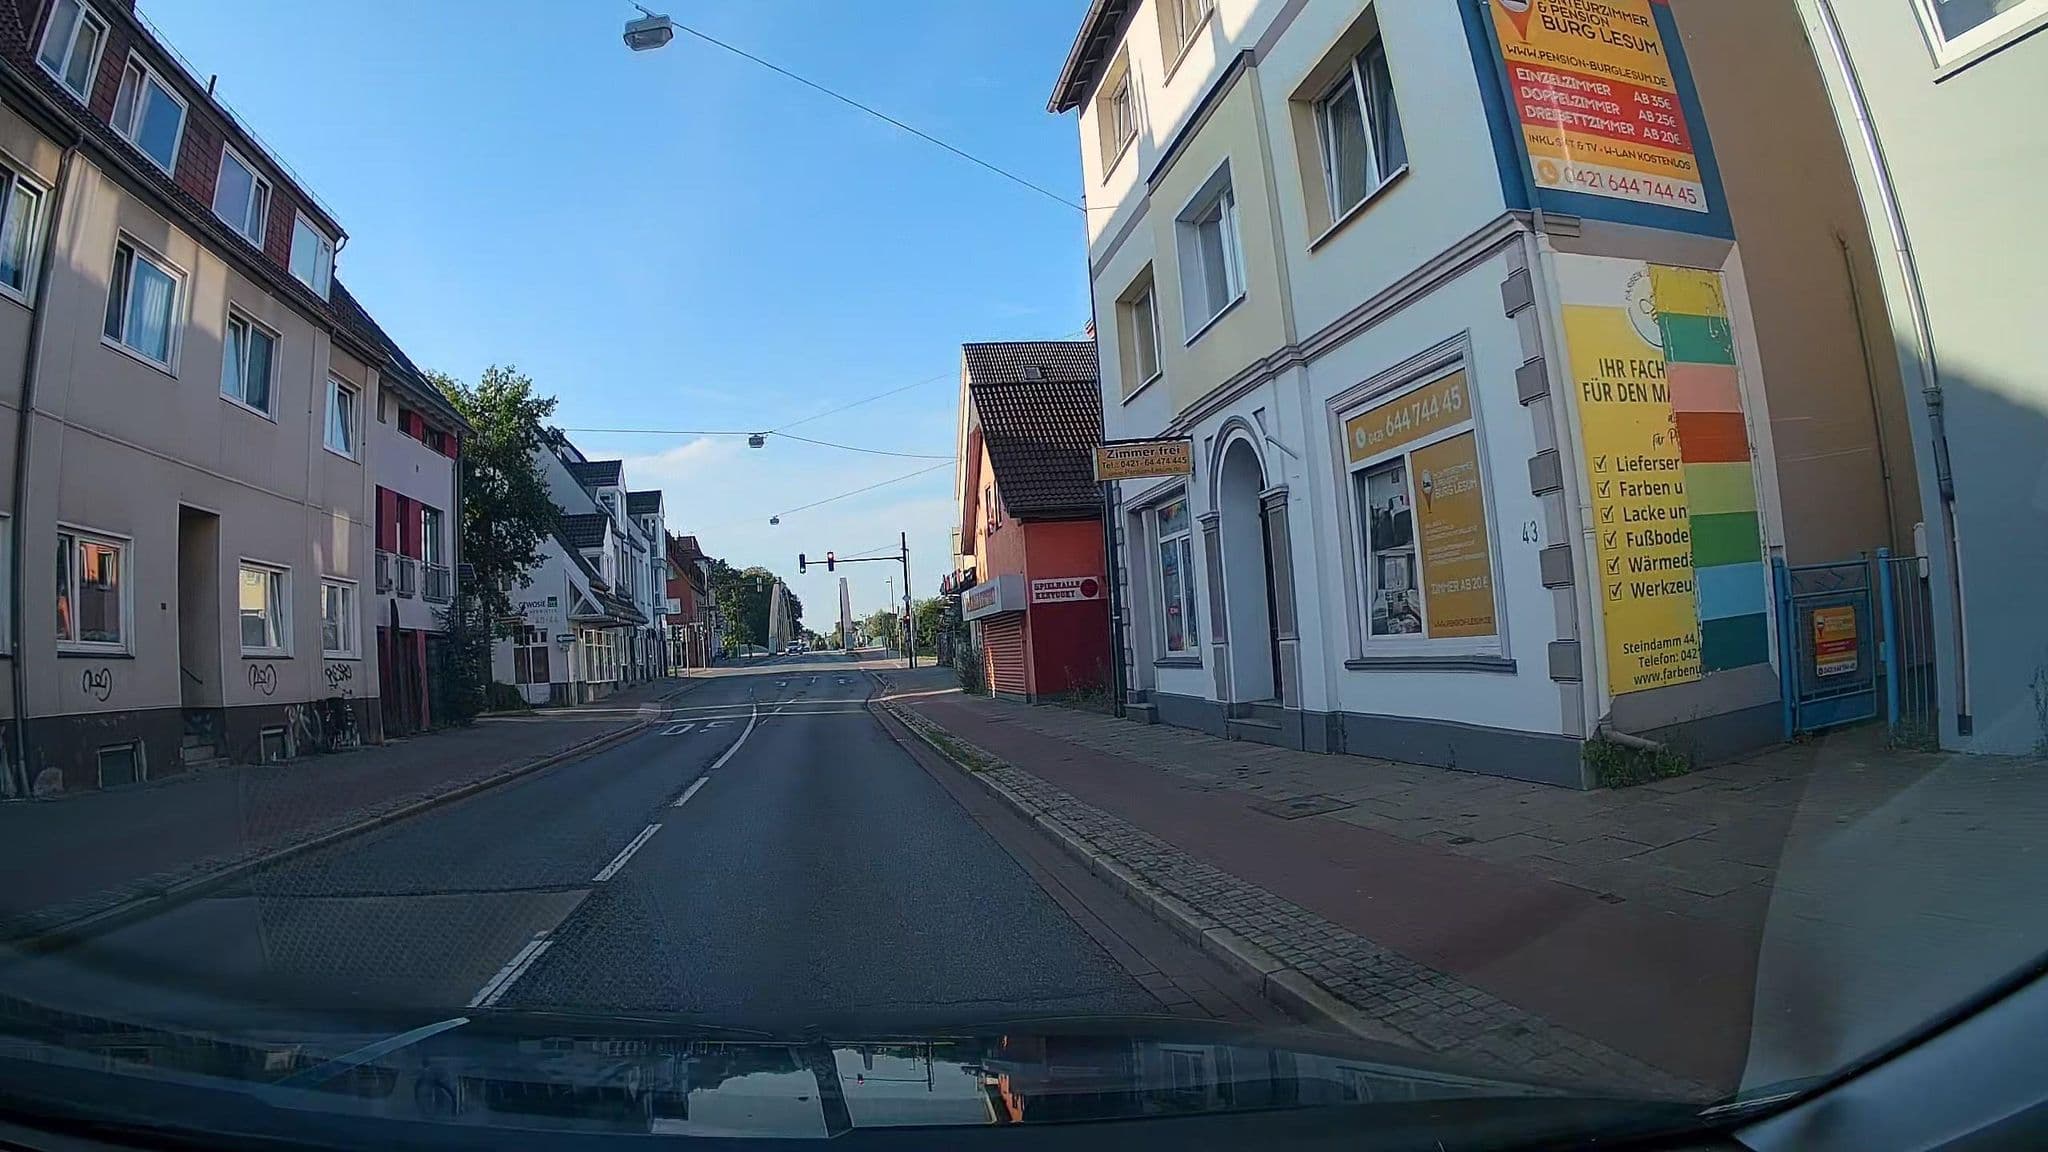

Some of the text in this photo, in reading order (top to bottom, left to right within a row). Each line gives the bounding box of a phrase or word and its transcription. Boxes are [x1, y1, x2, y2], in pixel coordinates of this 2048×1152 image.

[1549, 0, 1650, 27] NTEURZIMMER
[1551, 4, 1610, 27] PENSION
[1541, 14, 1659, 56] BURG LESUM
[1505, 43, 1668, 87] WWW.PENSION-BURGLESUM.DE
[1516, 67, 1673, 110] EINZELZIMMER AB 35€
[1520, 86, 1677, 128] DOPPELZIMMER AB 25€
[1524, 105, 1682, 146] DREIBETTZIMMER AB 20€
[1586, 143, 1597, 152] TV
[1637, 151, 1692, 170] KOSTENLOS
[1564, 166, 1697, 205] 0421 644 744 45
[1599, 358, 1665, 379] IHR FACH
[1583, 376, 1613, 402] FÜR
[1617, 382, 1648, 403] DEN
[1385, 407, 1411, 437] 644
[1412, 394, 1439, 426] 744
[1442, 385, 1462, 413] 45
[1107, 445, 1180, 459] Zimmer frei
[1120, 460, 1139, 468] 0421
[1616, 455, 1680, 473] Lieferser
[1619, 480, 1683, 497] Farben u
[1623, 504, 1687, 522] Lacke un
[1521, 520, 1540, 544] 43
[1626, 529, 1689, 548] Fußbode
[1631, 579, 1695, 599] Werkzeu
[1623, 637, 1681, 654] Steindamm
[1638, 648, 1700, 668] Telefon: 042
